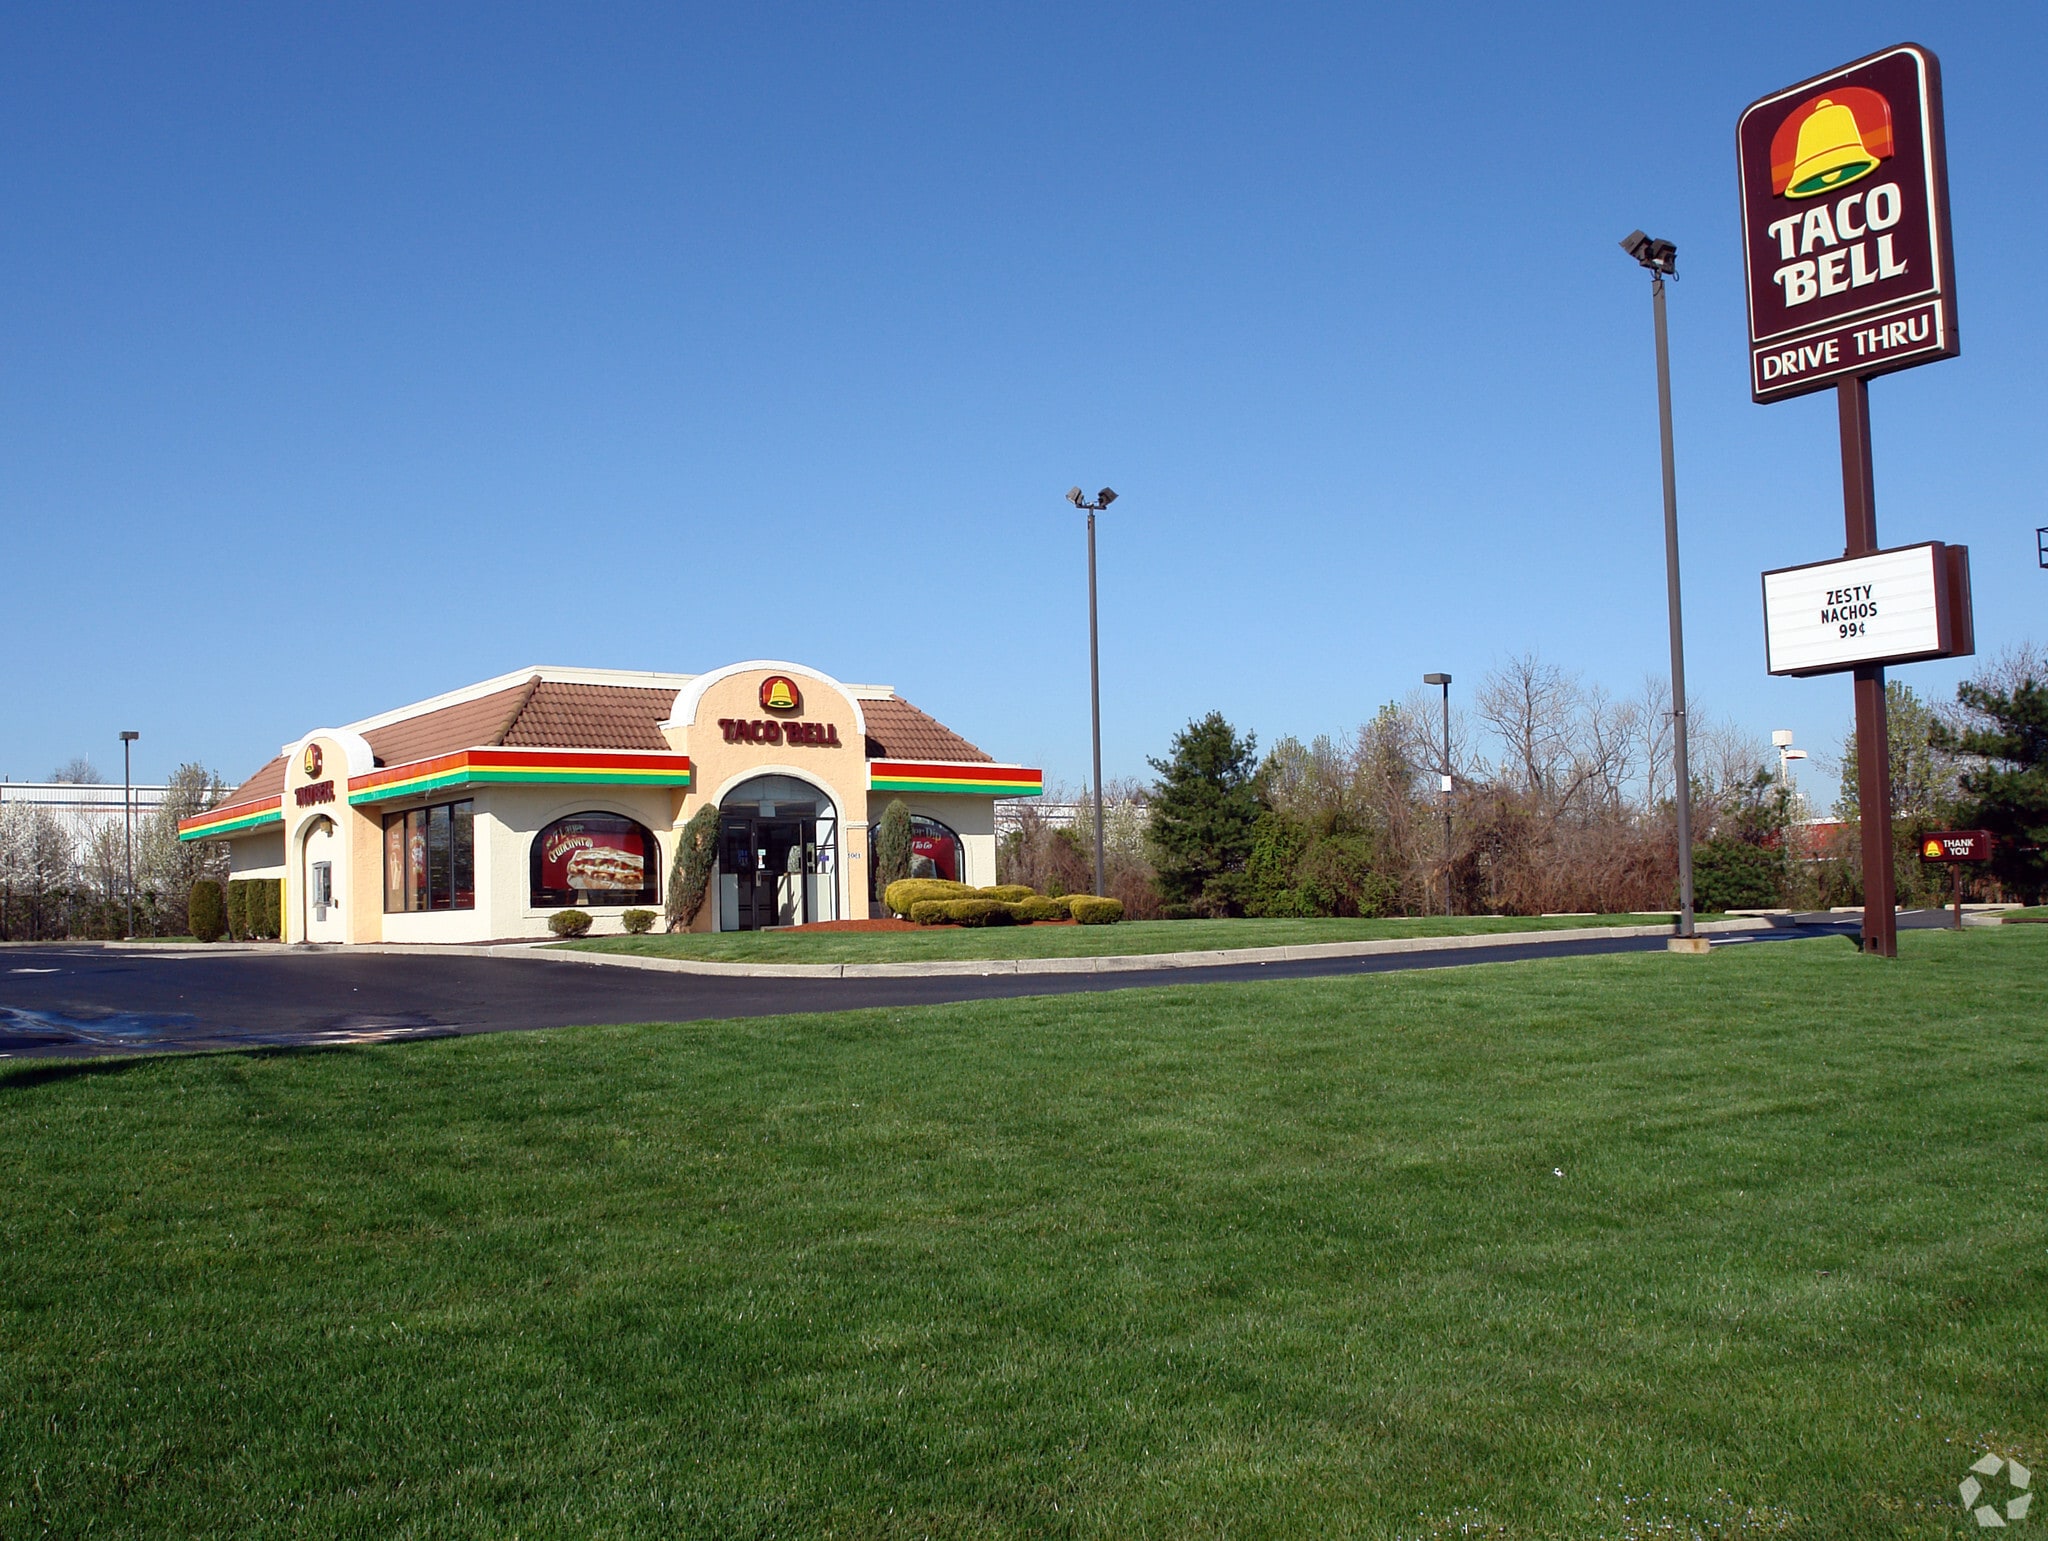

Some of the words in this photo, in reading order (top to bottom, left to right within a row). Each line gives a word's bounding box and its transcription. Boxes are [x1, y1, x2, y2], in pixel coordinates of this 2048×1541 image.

[1768, 182, 1902, 260] TACO
[1774, 233, 1908, 309] BELL
[1763, 338, 1840, 380] DRIVE
[1853, 314, 1930, 356] THRU
[1826, 584, 1872, 605] ZESTY
[1821, 602, 1878, 624] NACHOS
[1839, 621, 1866, 638] 99¢
[718, 718, 780, 741] TACO
[781, 721, 841, 744] BELL
[1943, 838, 1974, 848] THANK
[1949, 847, 1970, 856] YOU
